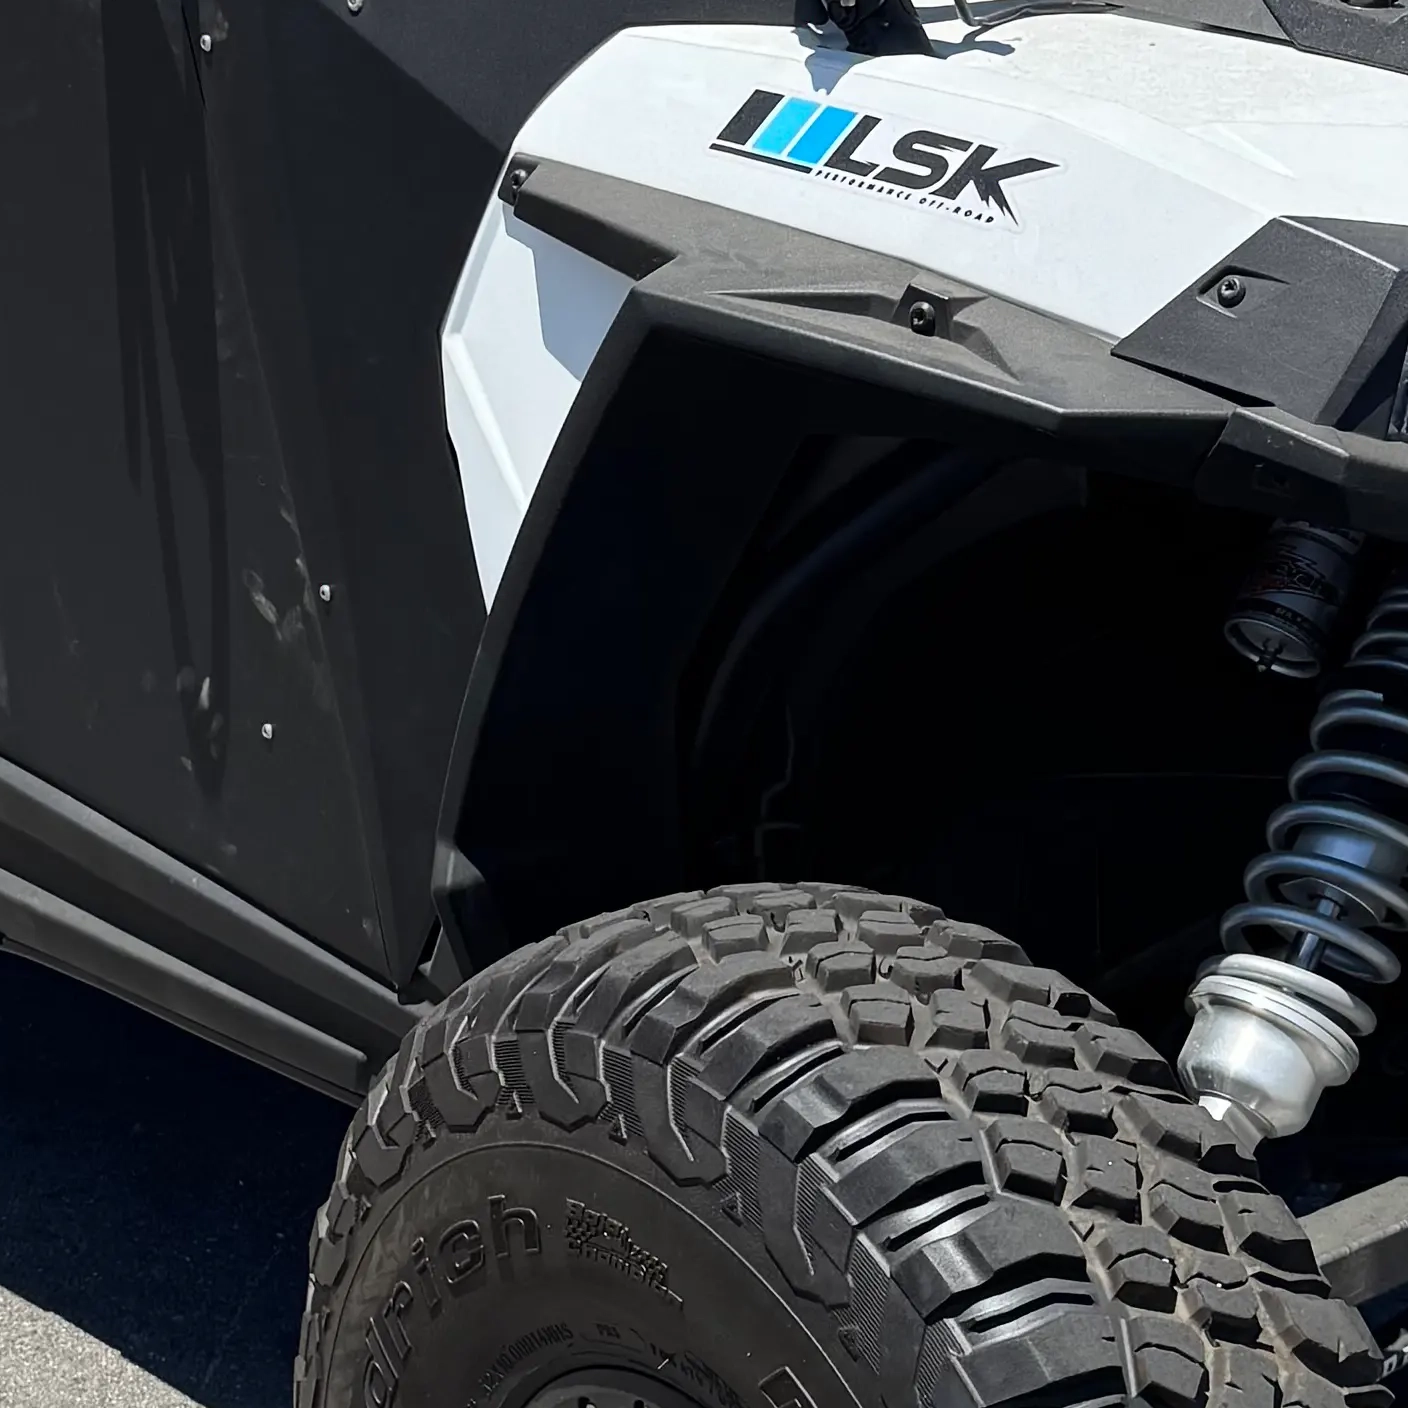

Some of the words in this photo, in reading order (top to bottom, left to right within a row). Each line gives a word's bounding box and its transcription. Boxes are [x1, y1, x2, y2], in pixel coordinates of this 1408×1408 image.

[814, 169, 912, 201] PERFORMANCE
[918, 196, 995, 224] OFF-ROAD
[824, 114, 1061, 226] LSK
